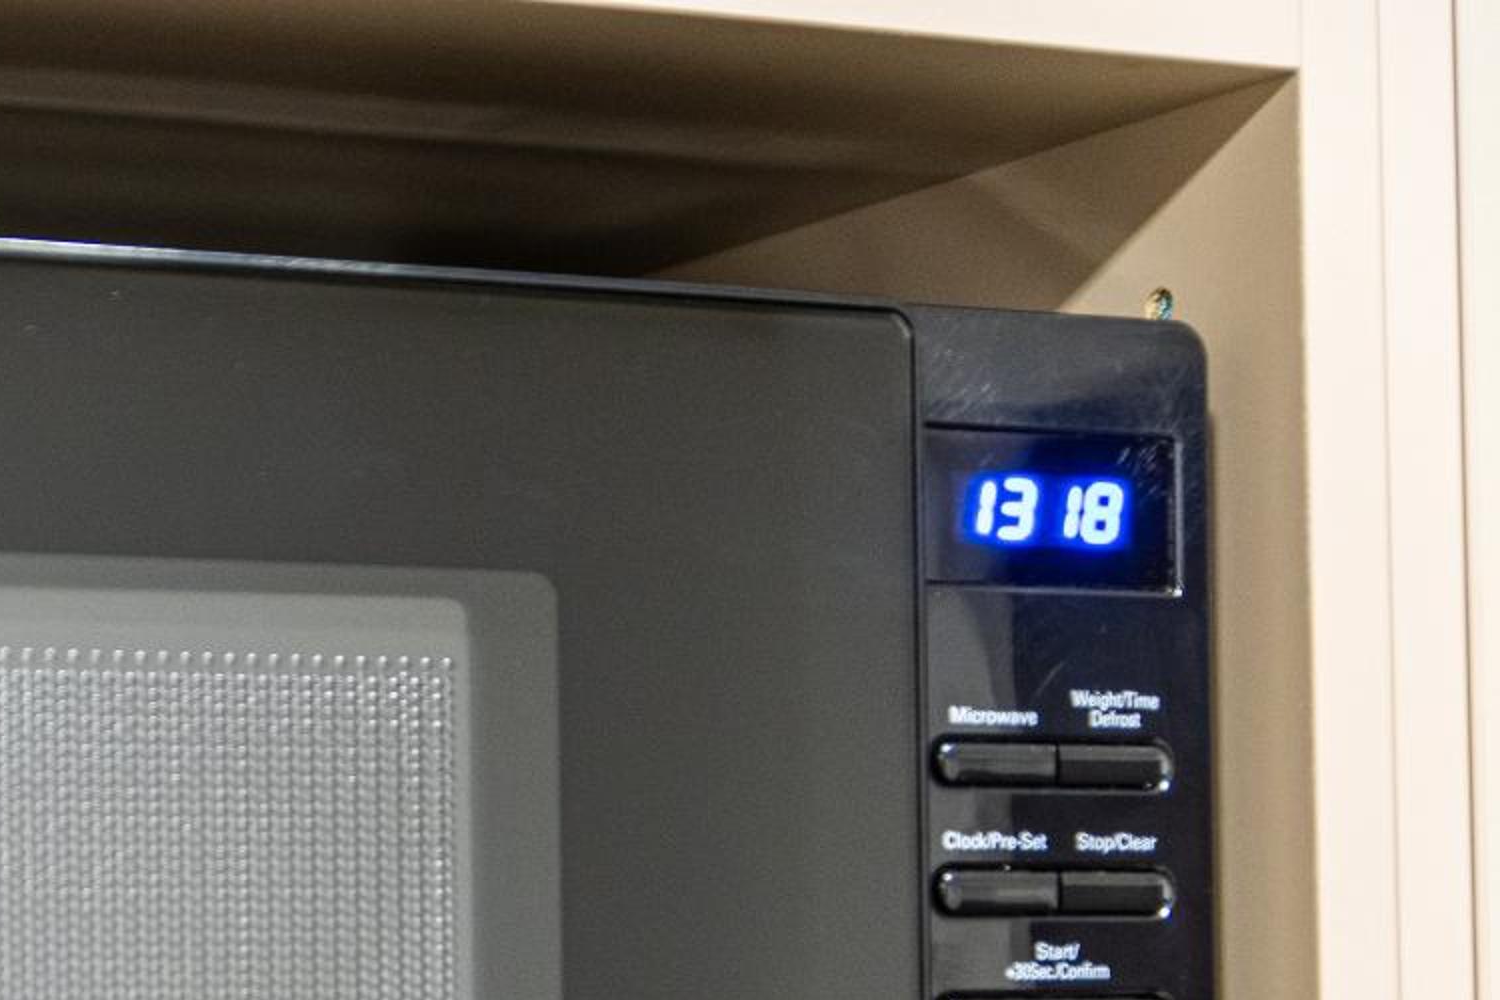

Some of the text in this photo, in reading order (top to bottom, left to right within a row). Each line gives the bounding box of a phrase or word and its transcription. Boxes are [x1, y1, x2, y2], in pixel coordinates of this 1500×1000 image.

[1070, 689, 1161, 711] Weight/Time
[948, 706, 1039, 726] Microwave
[1088, 711, 1141, 728] Defrost
[942, 831, 1048, 851] Clock/Pre-Set
[1074, 832, 1157, 854] Stop/Clear
[1034, 941, 1080, 960] Start/
